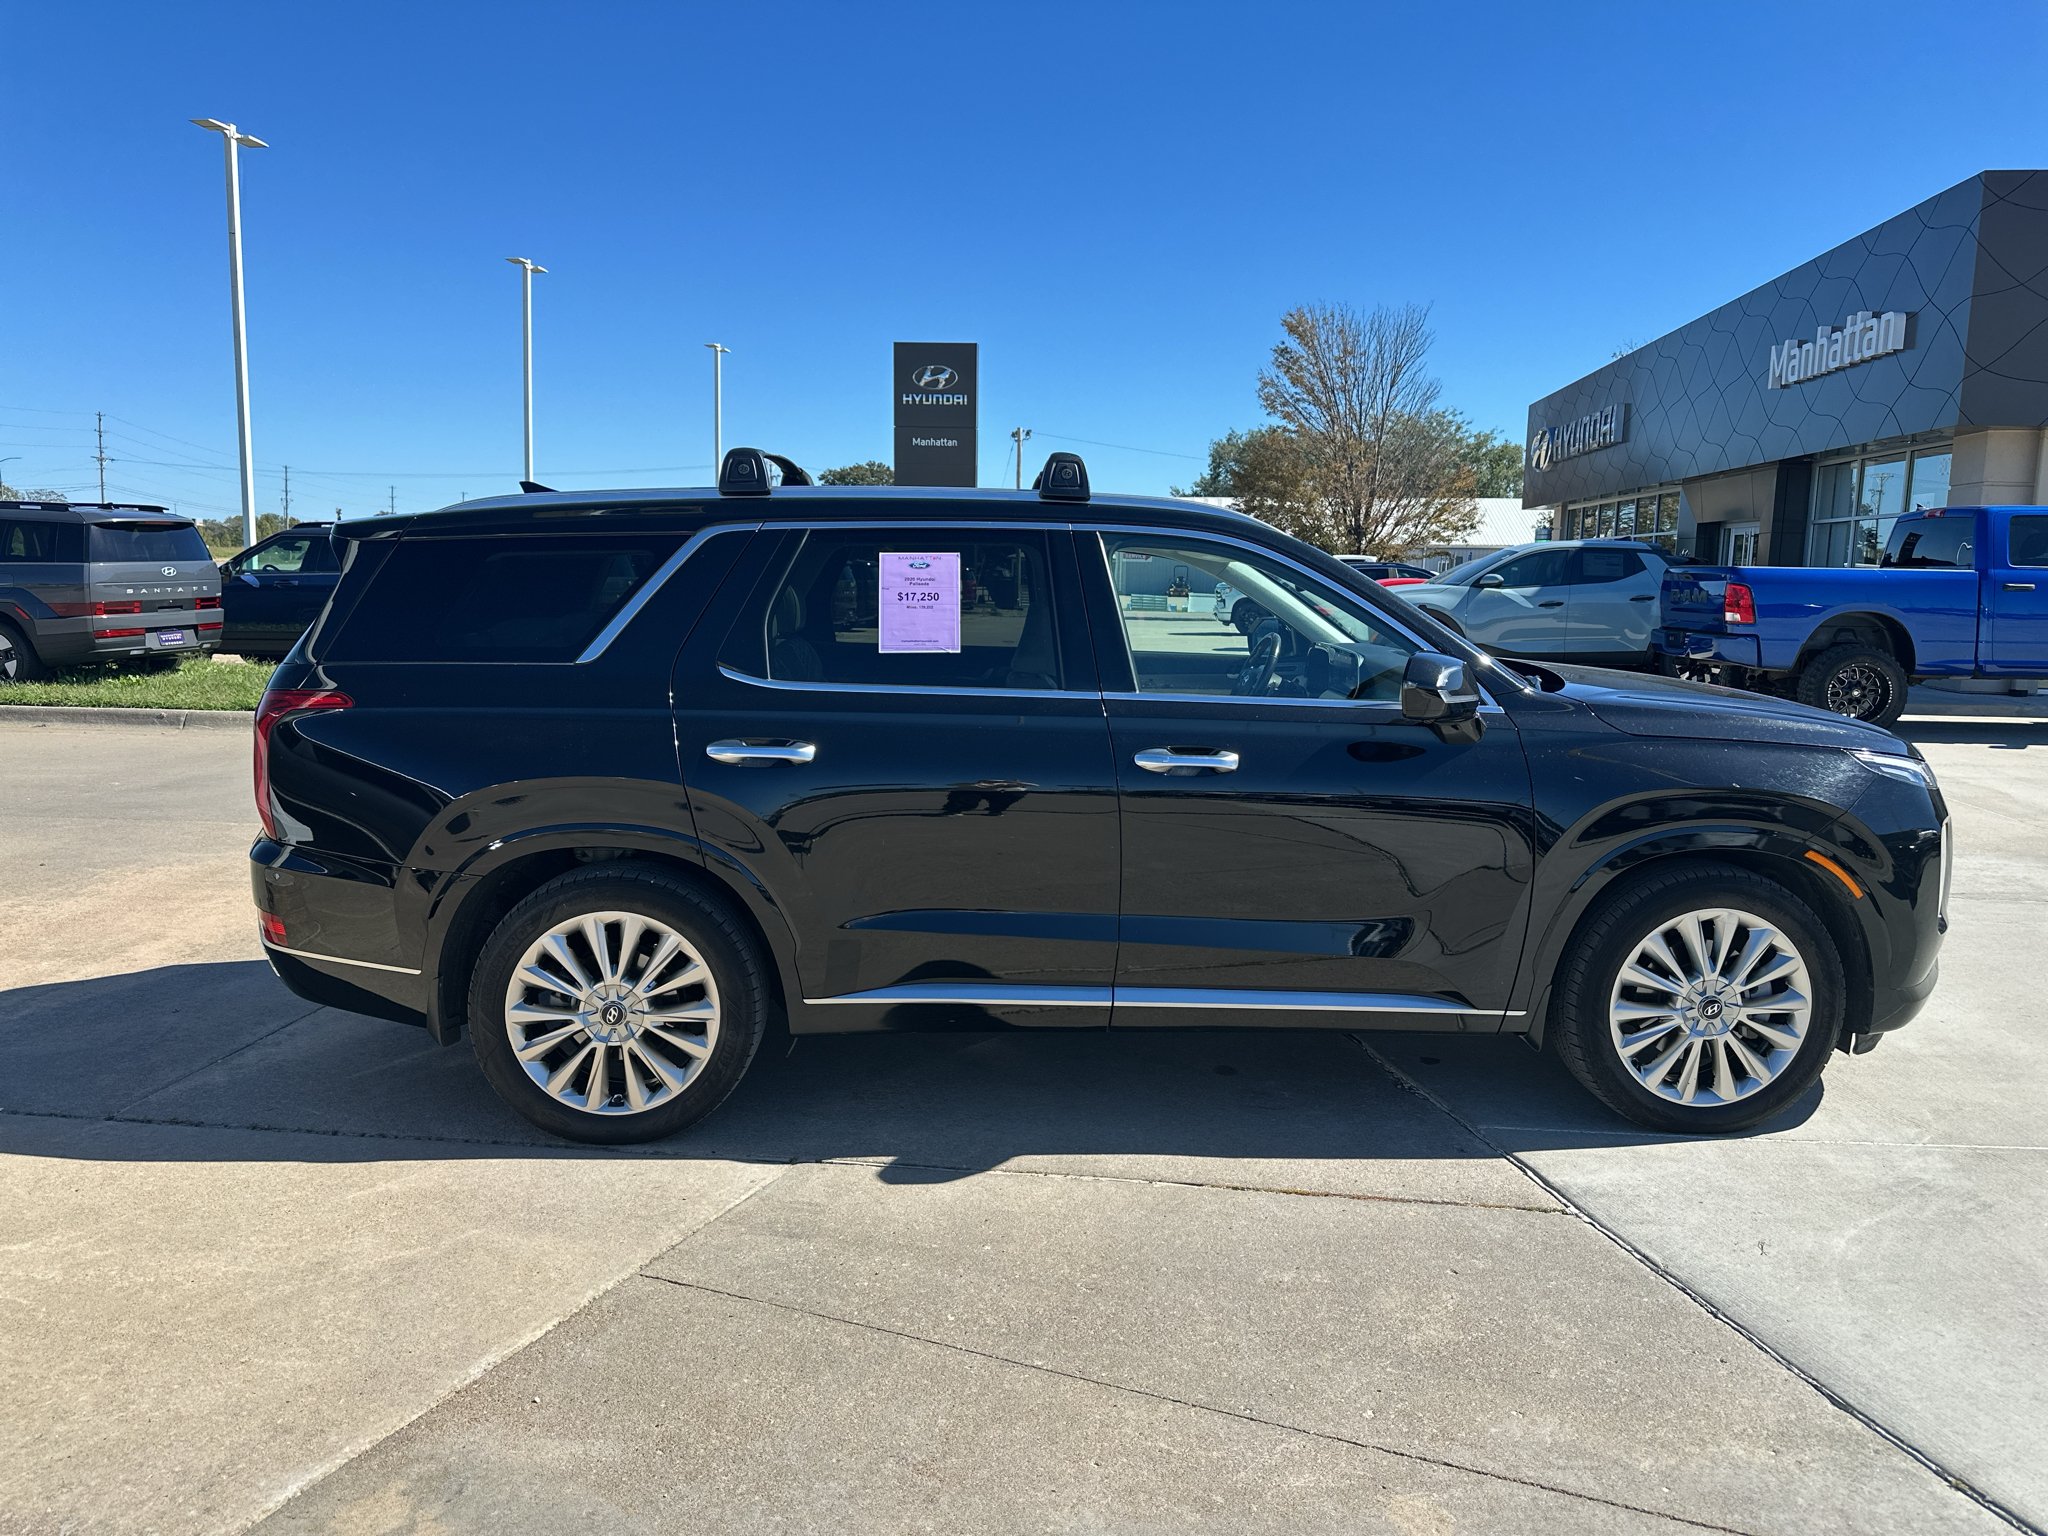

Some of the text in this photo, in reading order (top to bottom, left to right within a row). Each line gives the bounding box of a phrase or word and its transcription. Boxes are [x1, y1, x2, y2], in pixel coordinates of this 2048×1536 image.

[1768, 311, 1906, 389] Manhattan
[902, 393, 967, 405] HYUNDAI
[1553, 403, 1621, 462] HYUNDAI
[912, 437, 958, 447] Manhattan
[897, 591, 940, 602] $17,250
